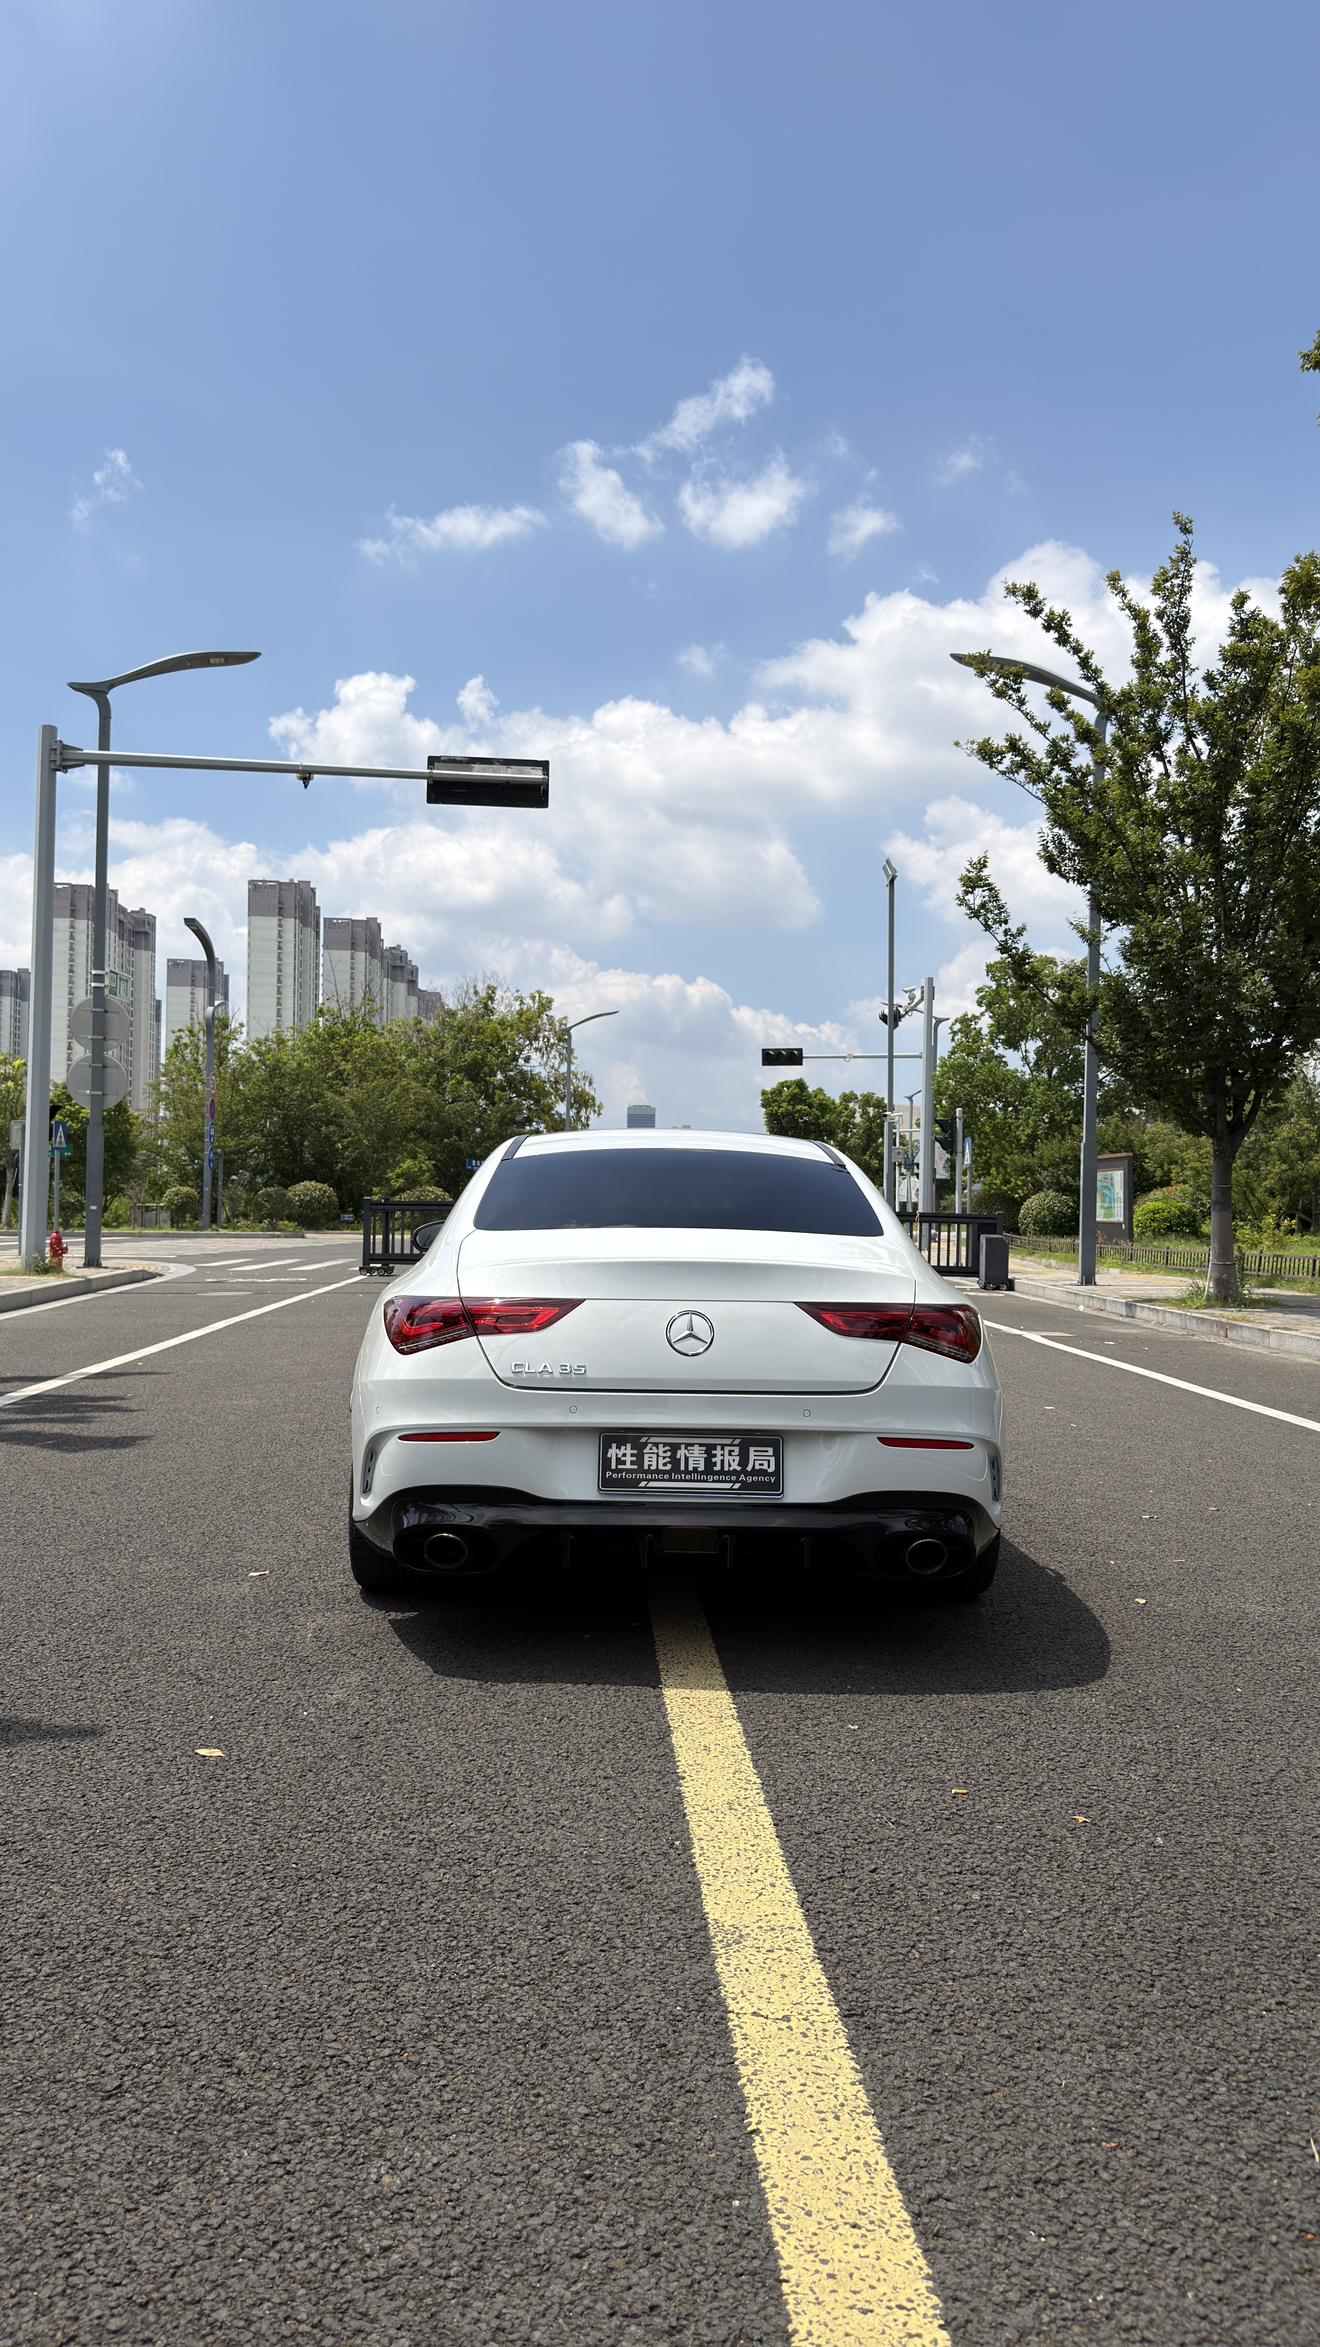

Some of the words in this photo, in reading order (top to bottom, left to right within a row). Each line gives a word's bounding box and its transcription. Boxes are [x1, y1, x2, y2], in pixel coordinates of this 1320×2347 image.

[511, 1361, 553, 1374] CLA
[559, 1362, 587, 1375] 35
[606, 1443, 776, 1473] 性能情报局
[605, 1471, 670, 1480] Performance
[738, 1473, 776, 1483] Agency
